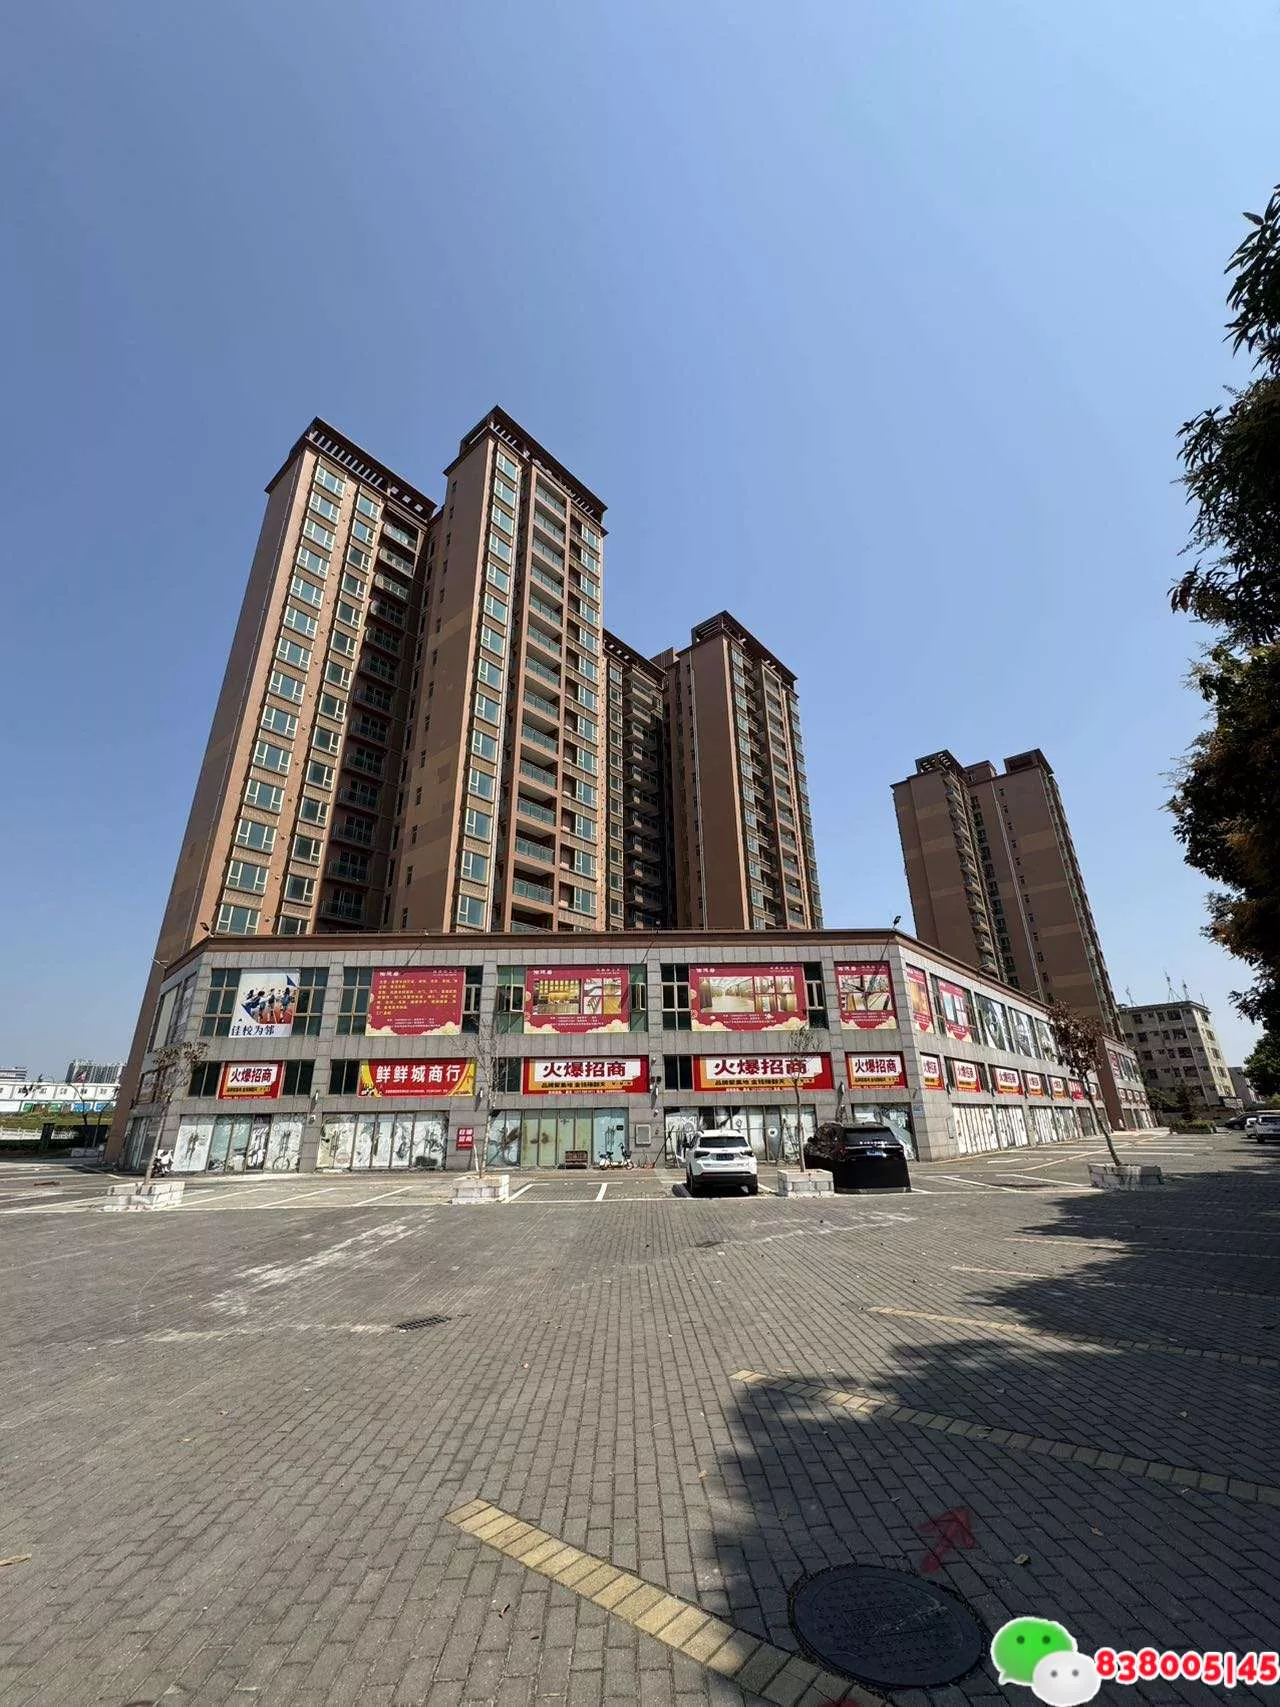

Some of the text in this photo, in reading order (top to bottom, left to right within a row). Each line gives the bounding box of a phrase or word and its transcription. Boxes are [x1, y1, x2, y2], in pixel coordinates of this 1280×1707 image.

[375, 1064, 461, 1083] 鲜鲜城商行
[542, 1061, 626, 1078] 火爆招商
[714, 1059, 807, 1075] 火爆招商
[855, 1058, 897, 1074] 火爆招商
[230, 1068, 273, 1083] 火爆招商
